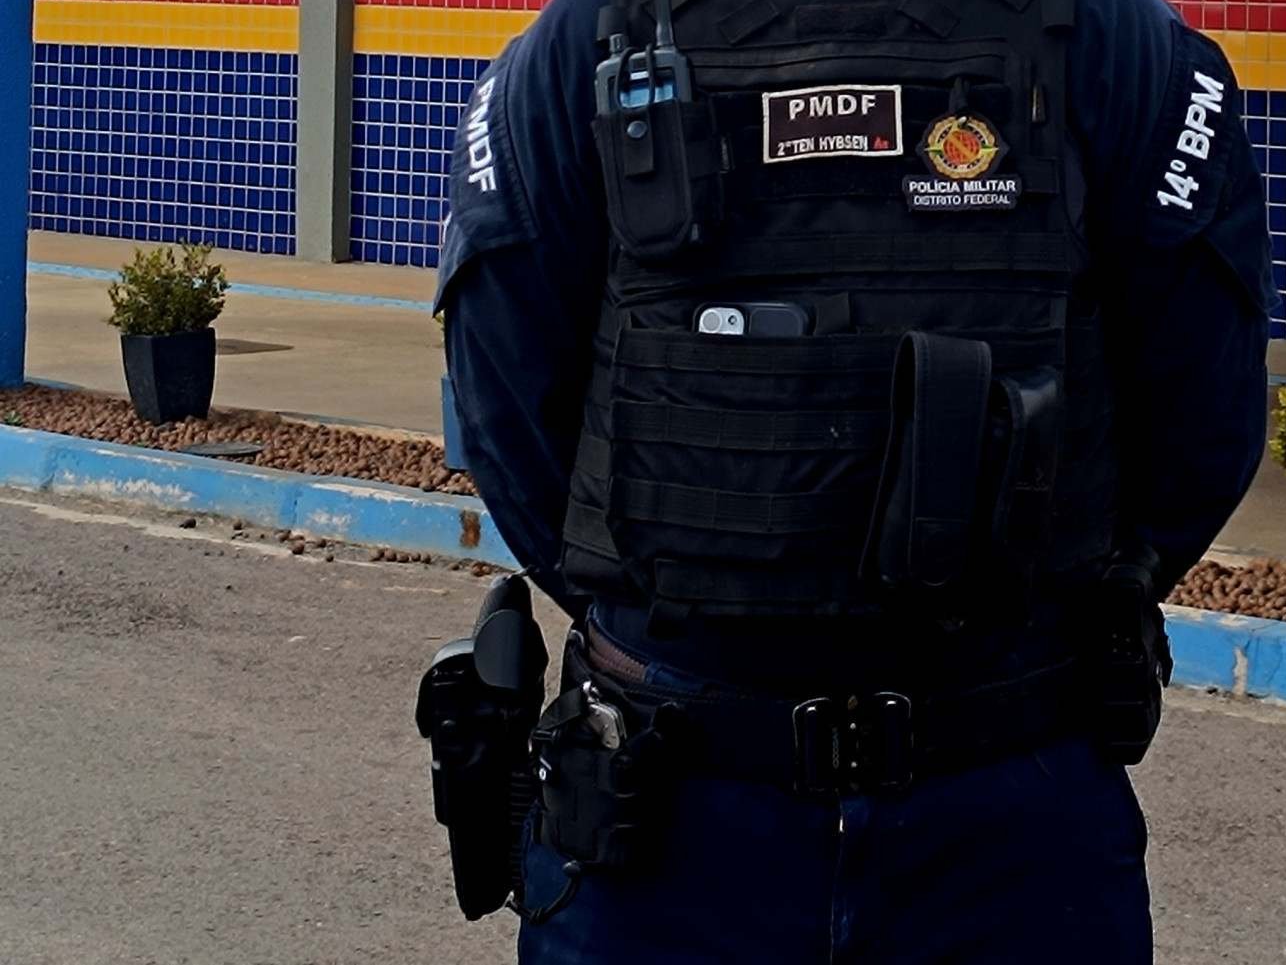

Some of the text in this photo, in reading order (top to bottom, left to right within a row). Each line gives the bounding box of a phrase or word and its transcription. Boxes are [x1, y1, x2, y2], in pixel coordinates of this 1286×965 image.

[788, 94, 877, 121] PMDF
[1176, 70, 1224, 159] BPM
[467, 77, 498, 192] PMDF
[963, 179, 1016, 192] MILITAR
[913, 194, 1011, 206] DISTRITO FEDERAL
